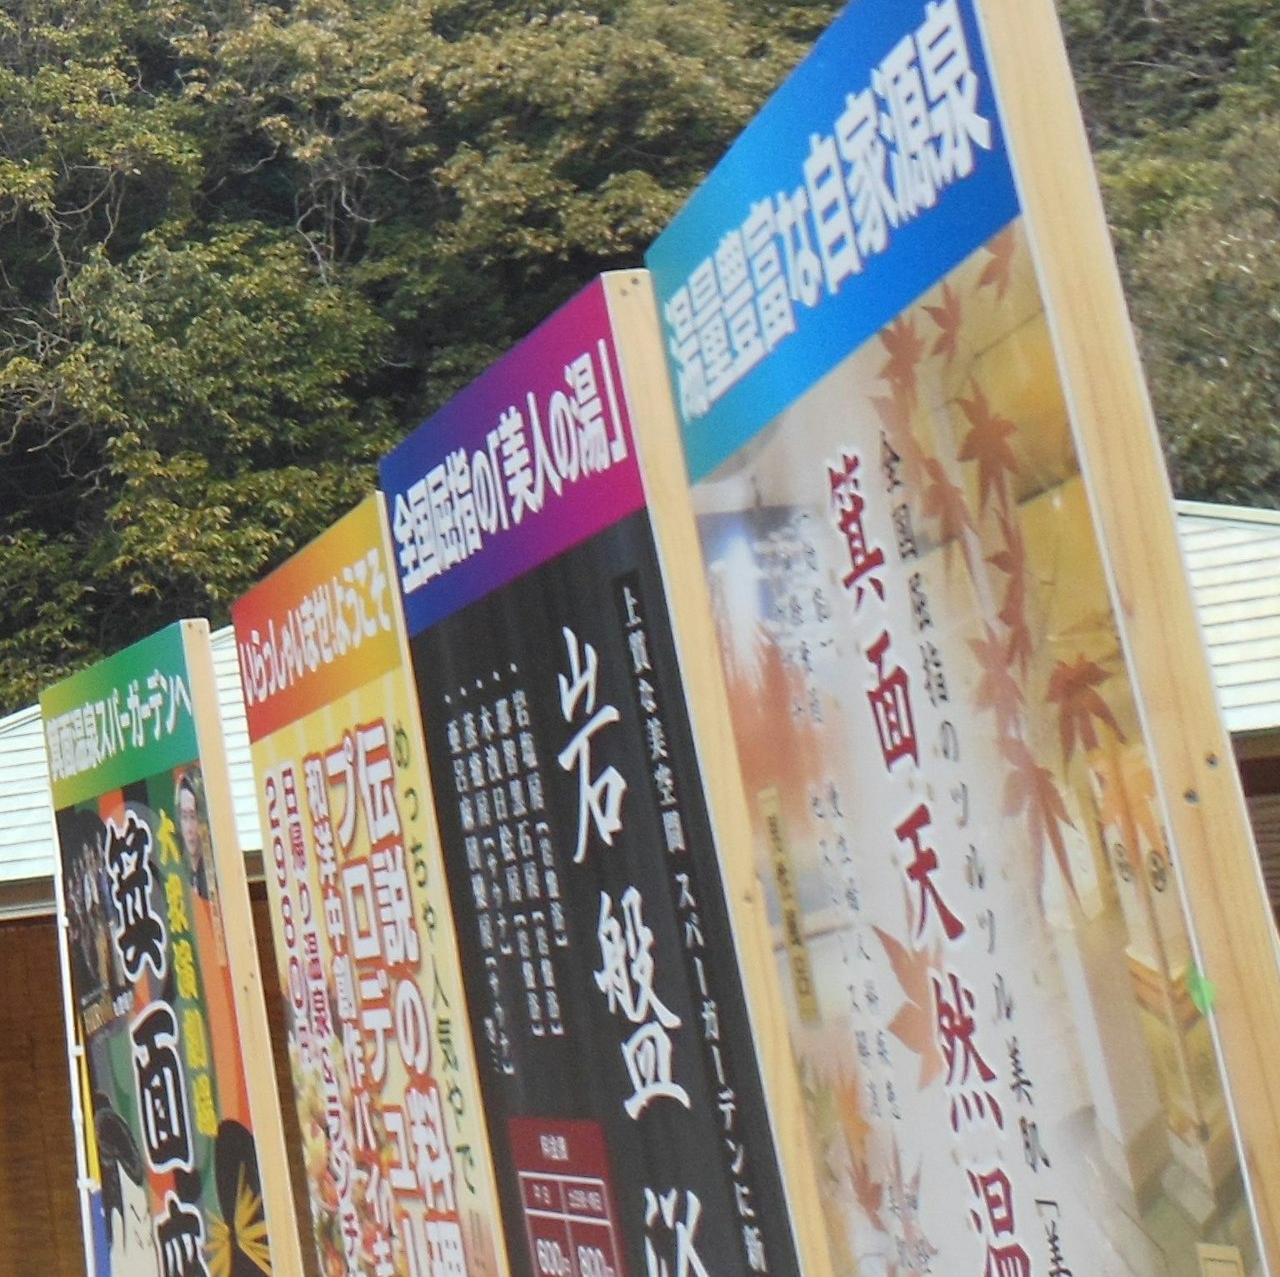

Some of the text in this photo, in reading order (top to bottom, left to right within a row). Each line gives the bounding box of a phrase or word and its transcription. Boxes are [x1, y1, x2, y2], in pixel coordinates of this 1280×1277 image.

[393, 337, 628, 594] 全国屈指の「美人の湯」
